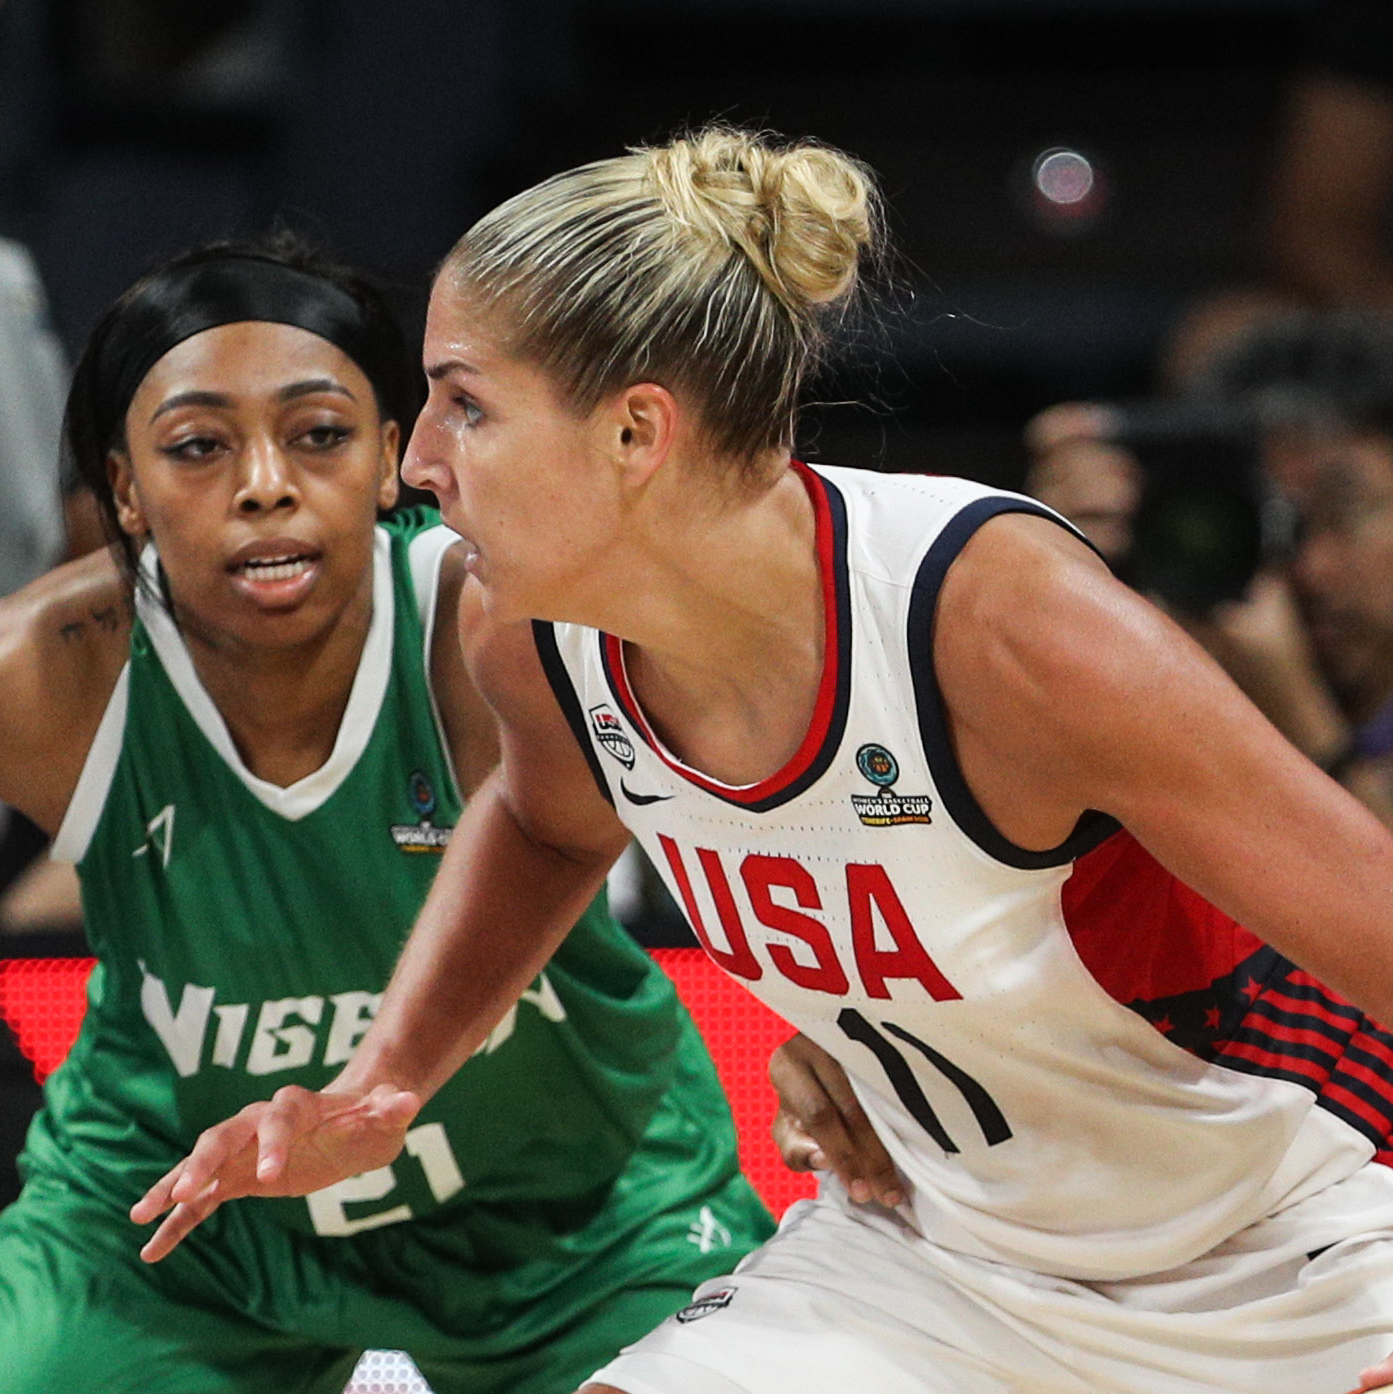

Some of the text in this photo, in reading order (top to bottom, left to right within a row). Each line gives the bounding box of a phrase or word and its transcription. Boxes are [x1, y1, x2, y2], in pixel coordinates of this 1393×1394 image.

[855, 803, 929, 816] WORLD CUP
[657, 832, 964, 1002] USA
[837, 1008, 1014, 1154] 11
[308, 1122, 465, 1237] 21
